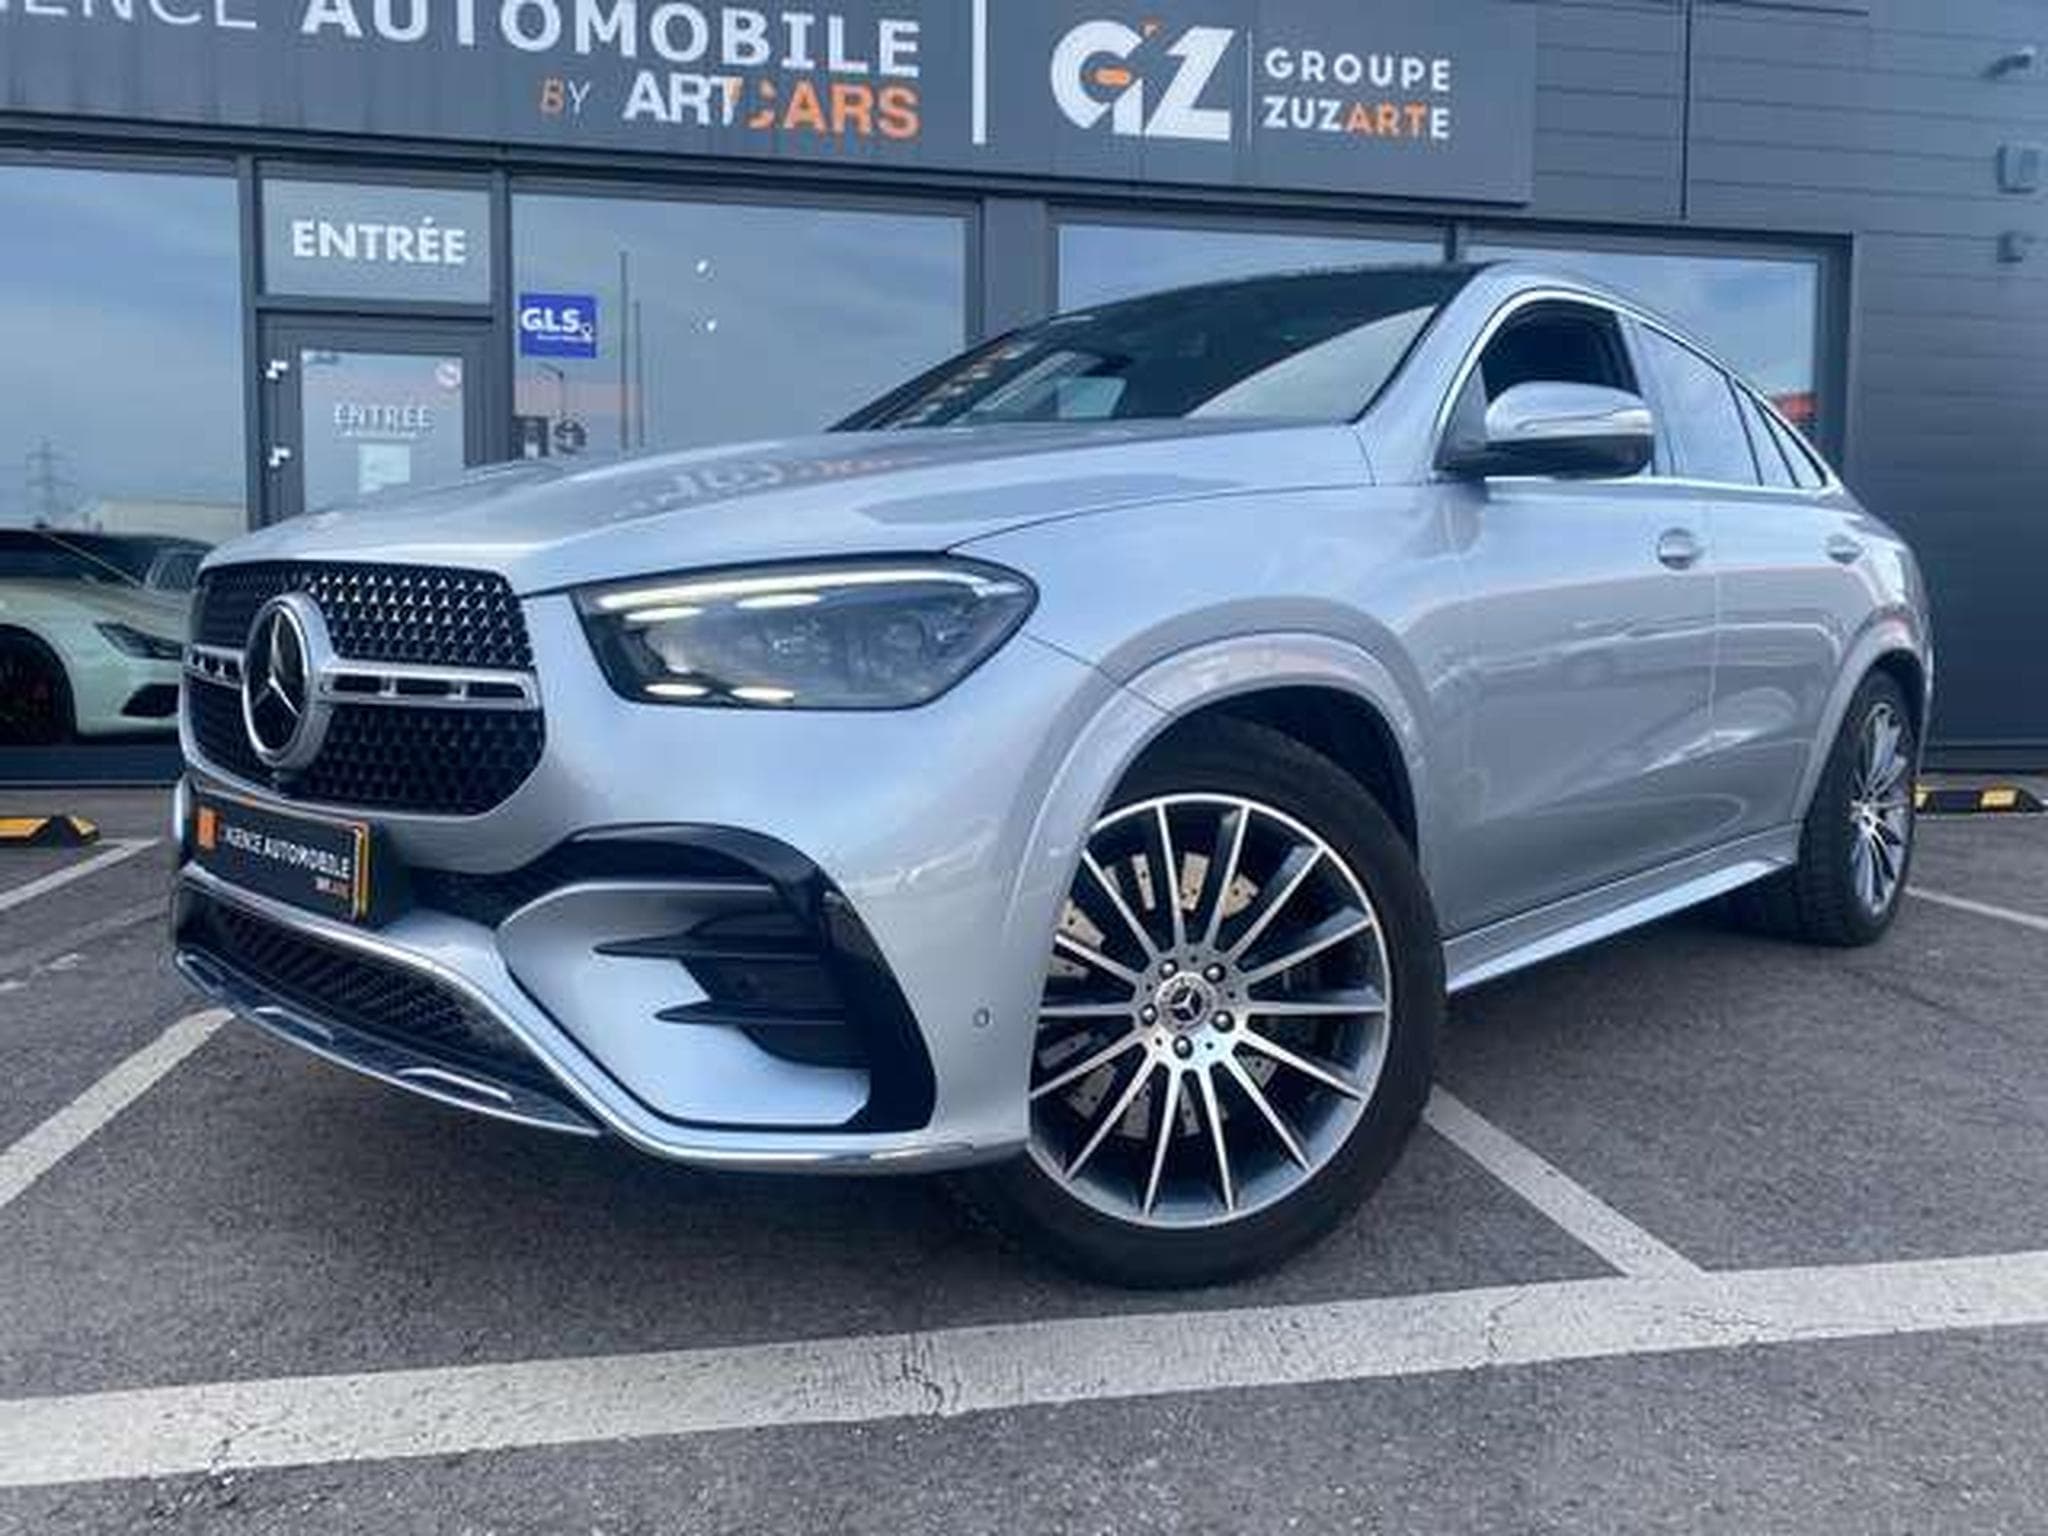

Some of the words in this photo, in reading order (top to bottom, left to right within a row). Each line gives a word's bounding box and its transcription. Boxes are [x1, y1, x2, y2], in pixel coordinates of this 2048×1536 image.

[301, 0, 921, 78] AUTOMOBILE
[1263, 47, 1452, 92] GROUPE
[540, 77, 590, 115] BY
[1262, 95, 1452, 140] ZUZARTE
[291, 216, 467, 265] ENTRÉE
[521, 307, 580, 334] GLS
